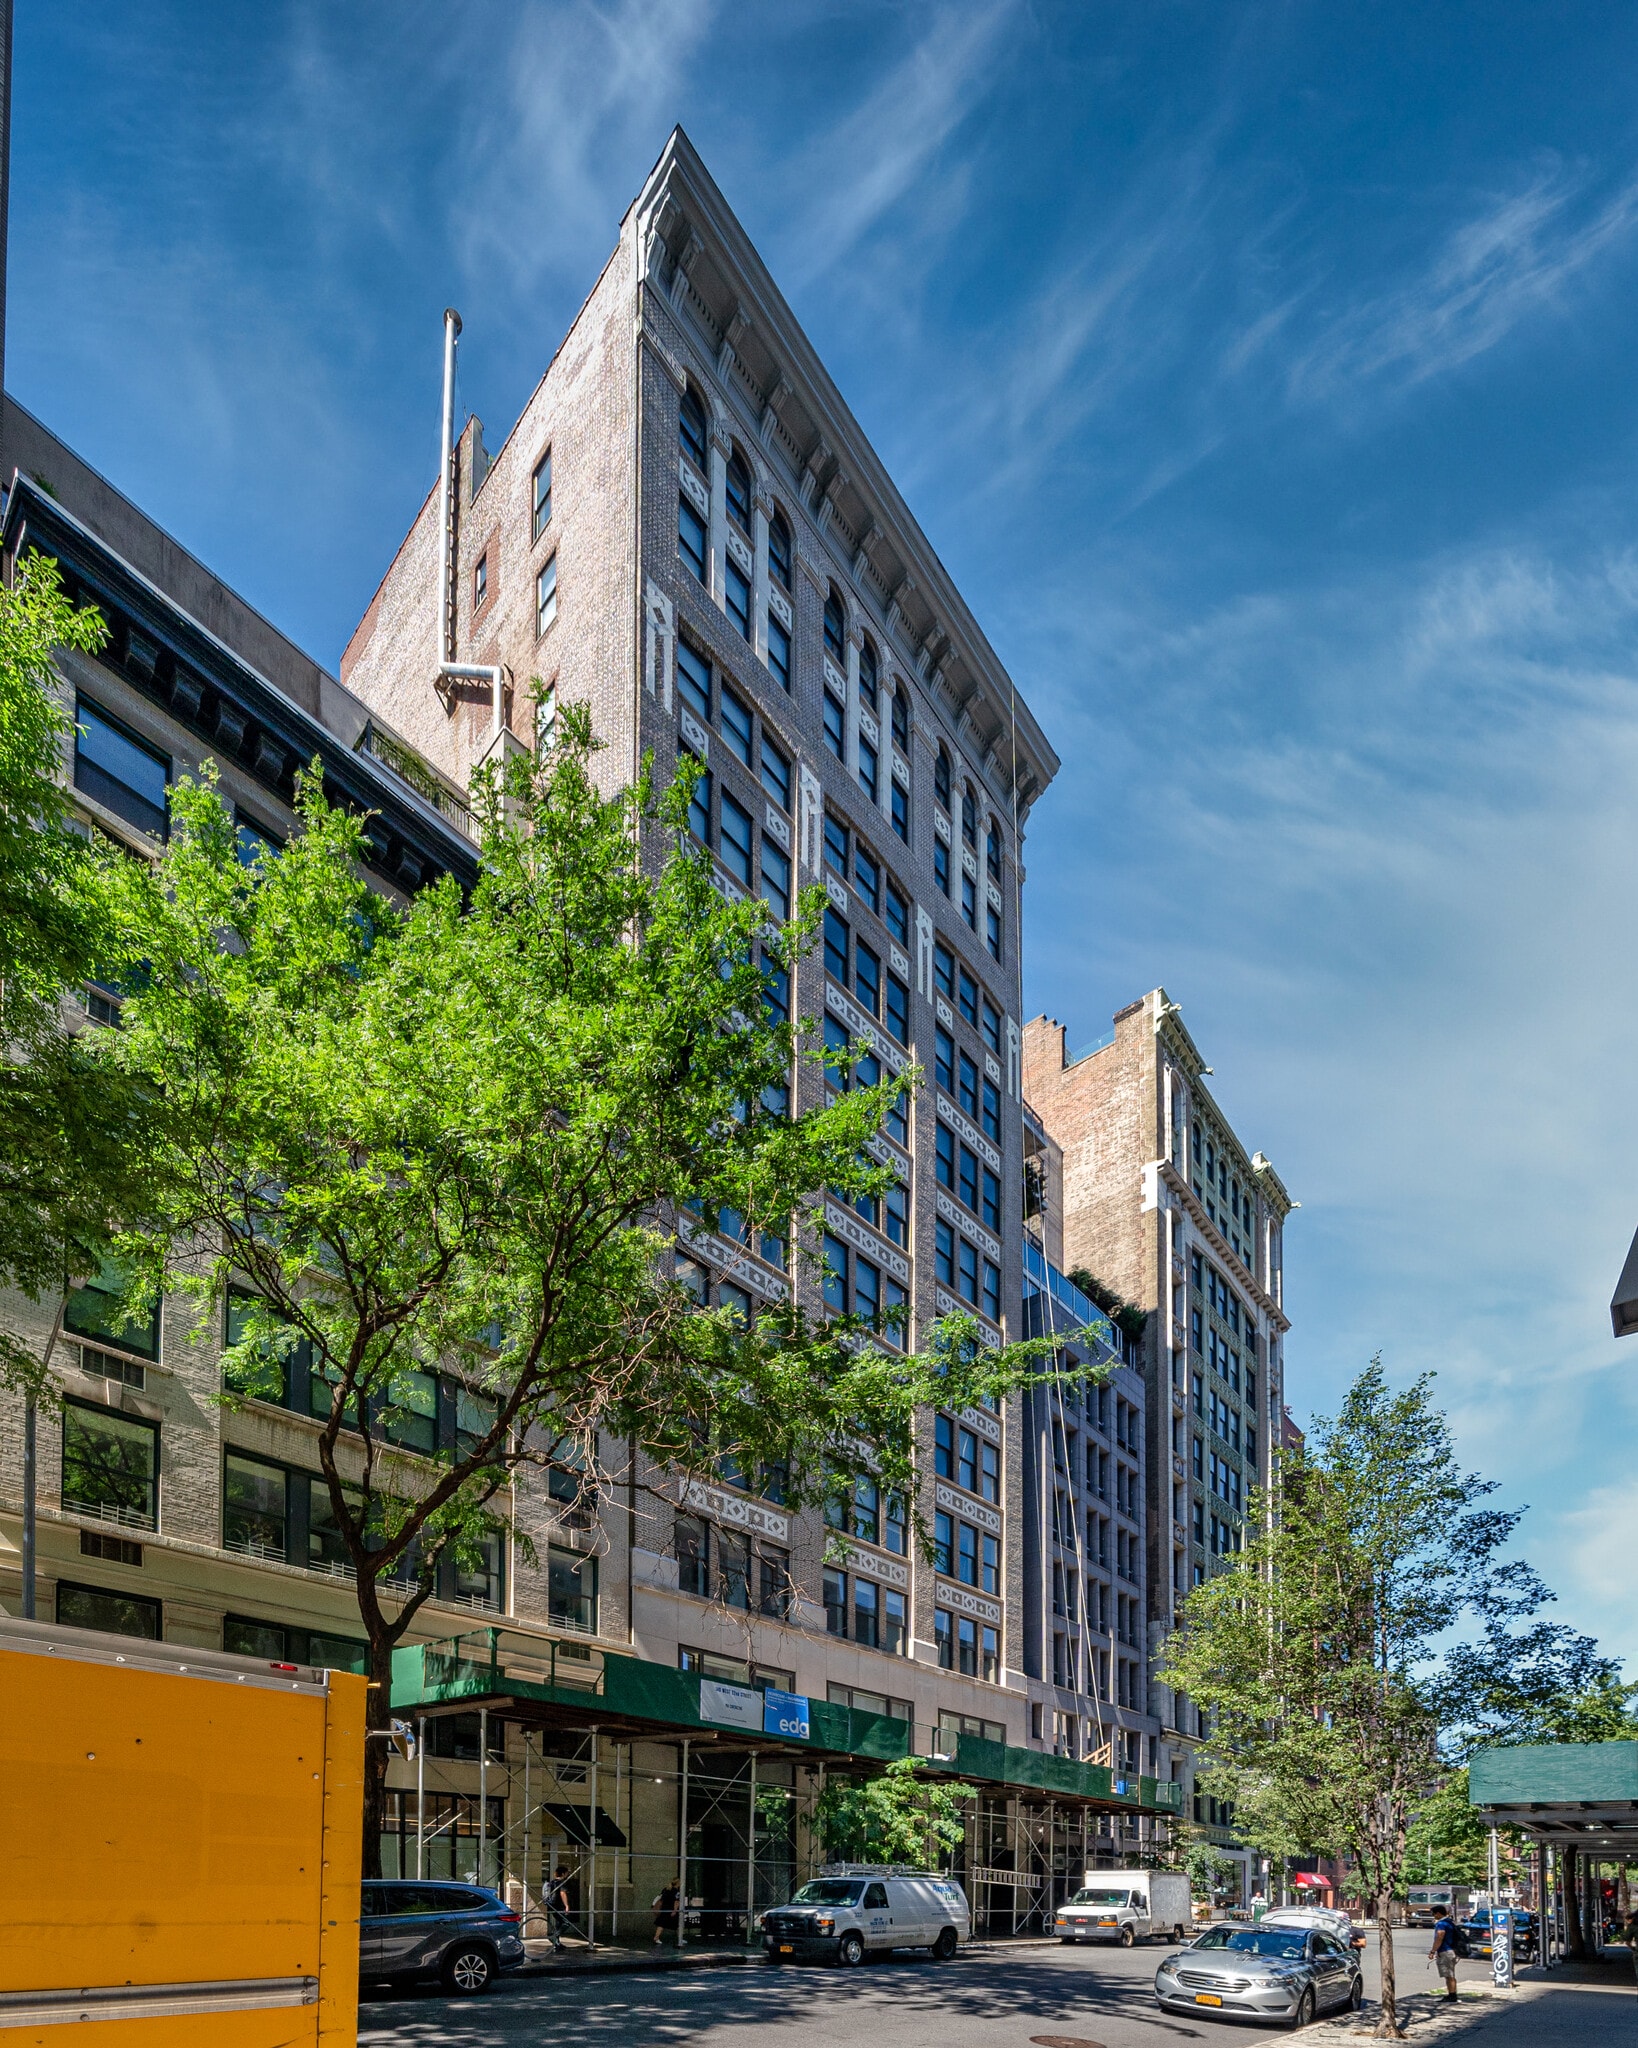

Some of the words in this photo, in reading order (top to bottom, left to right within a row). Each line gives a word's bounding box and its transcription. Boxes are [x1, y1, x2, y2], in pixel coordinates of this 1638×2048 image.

[933, 1883, 952, 1894] Aqua
[944, 1893, 960, 1901] Turf
[1497, 1914, 1505, 1923] P
